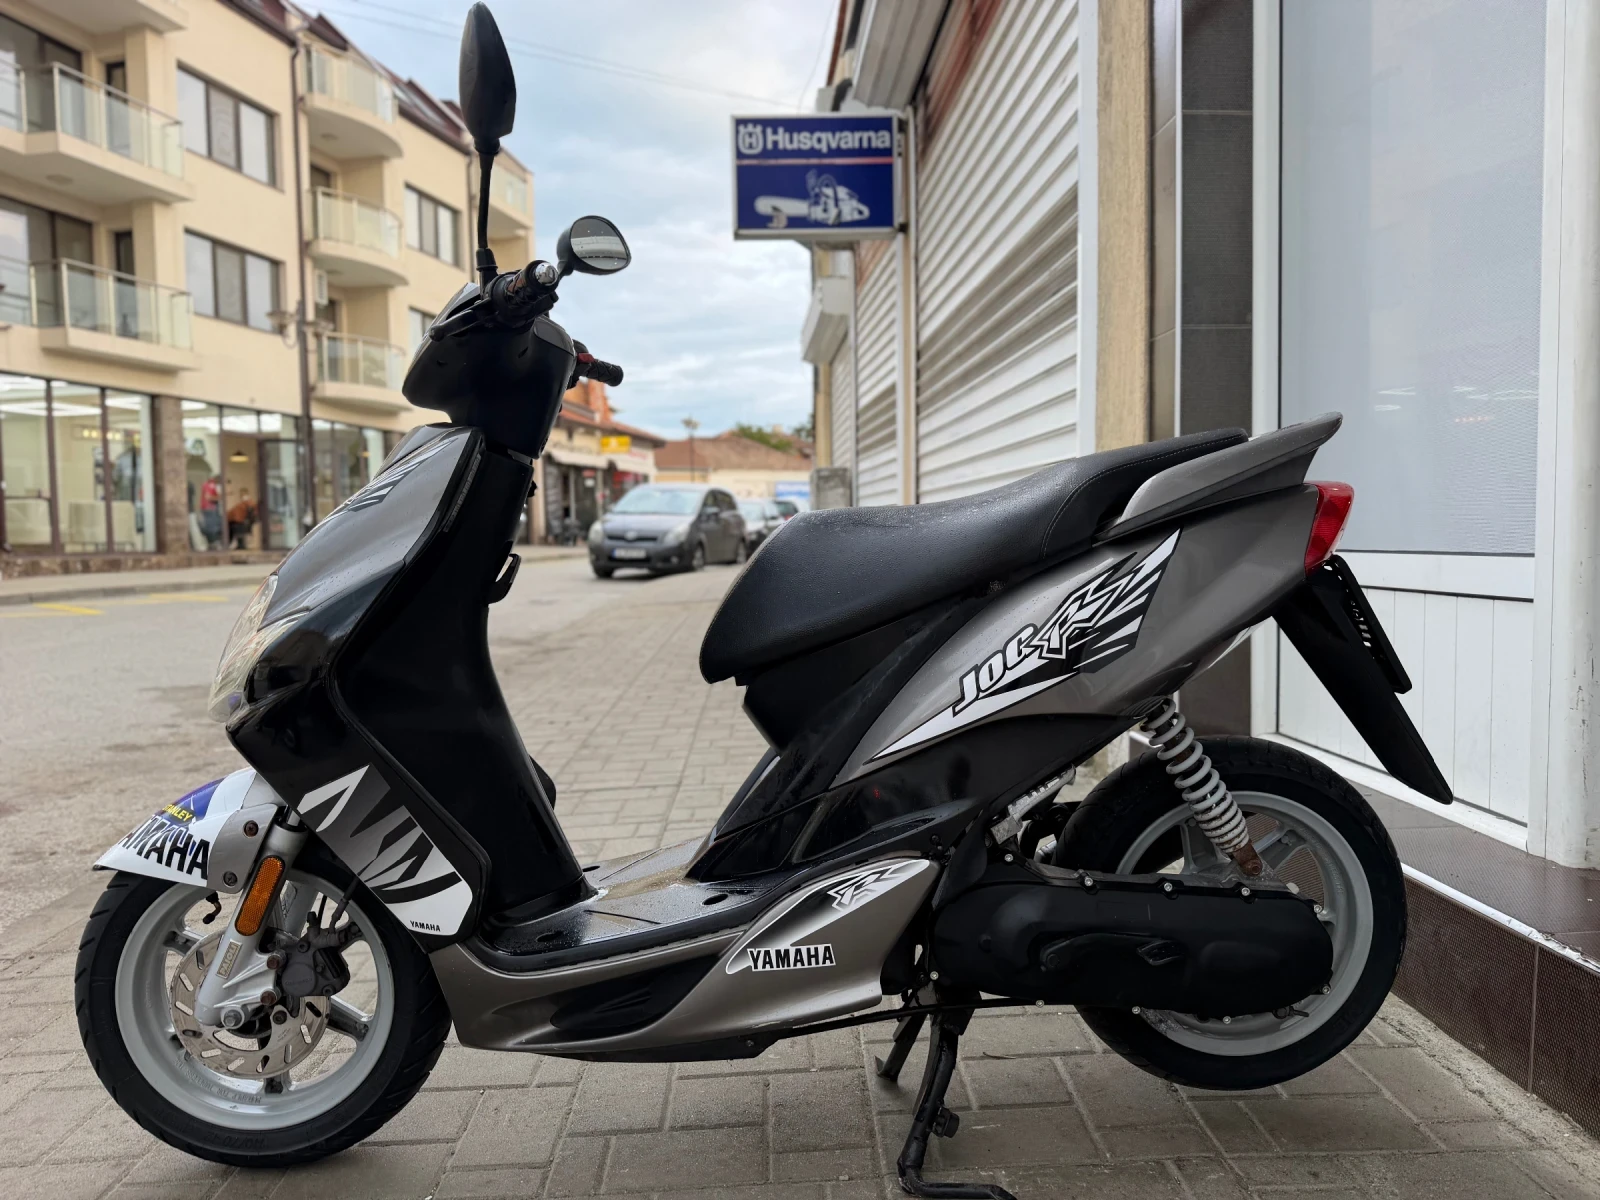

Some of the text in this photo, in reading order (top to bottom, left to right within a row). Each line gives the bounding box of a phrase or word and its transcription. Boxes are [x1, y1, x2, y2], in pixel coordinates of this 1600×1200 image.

[766, 127, 891, 153] Husqvarna
[117, 815, 210, 881] AMAHA
[410, 919, 441, 932] YAMAHA
[748, 945, 835, 970] YAMAHA
